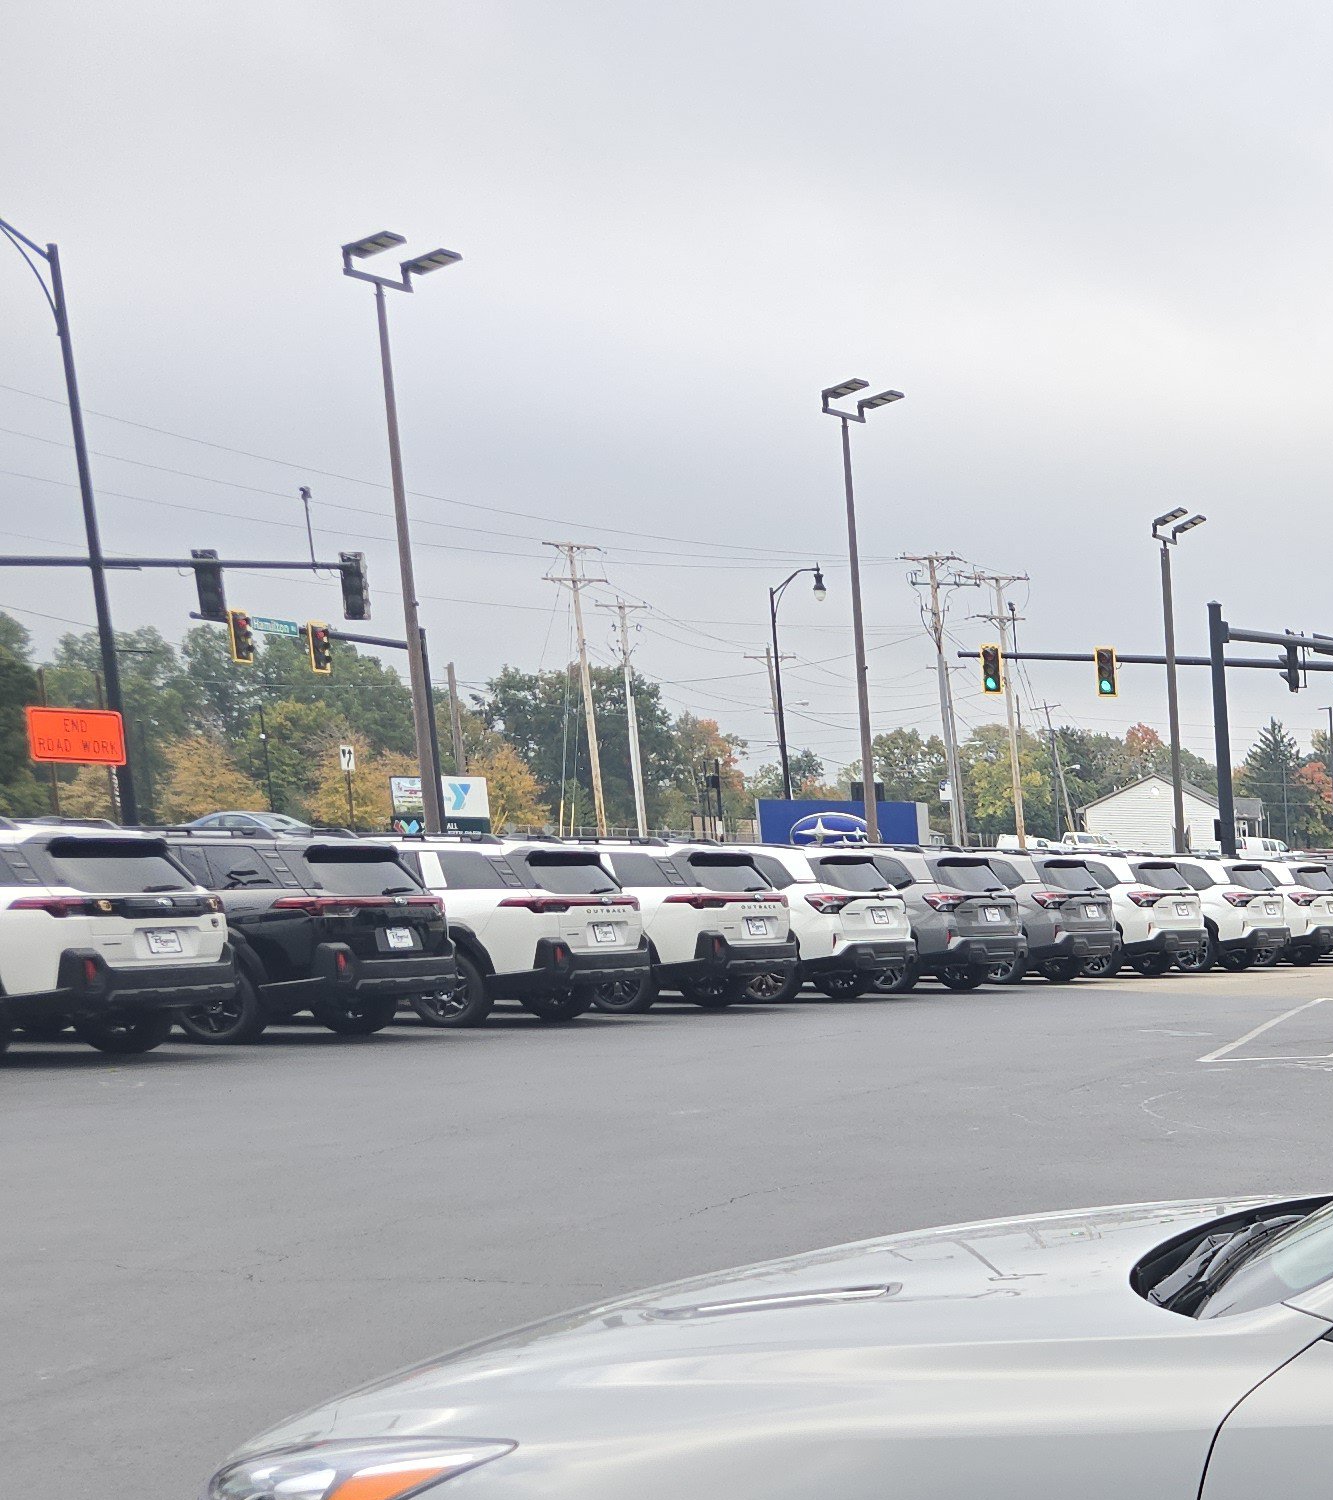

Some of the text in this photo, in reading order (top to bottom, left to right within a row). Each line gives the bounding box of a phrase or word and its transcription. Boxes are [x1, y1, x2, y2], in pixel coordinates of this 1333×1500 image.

[253, 619, 290, 634] Hamilton
[63, 718, 88, 733] END
[37, 737, 118, 755] ROAD WORK
